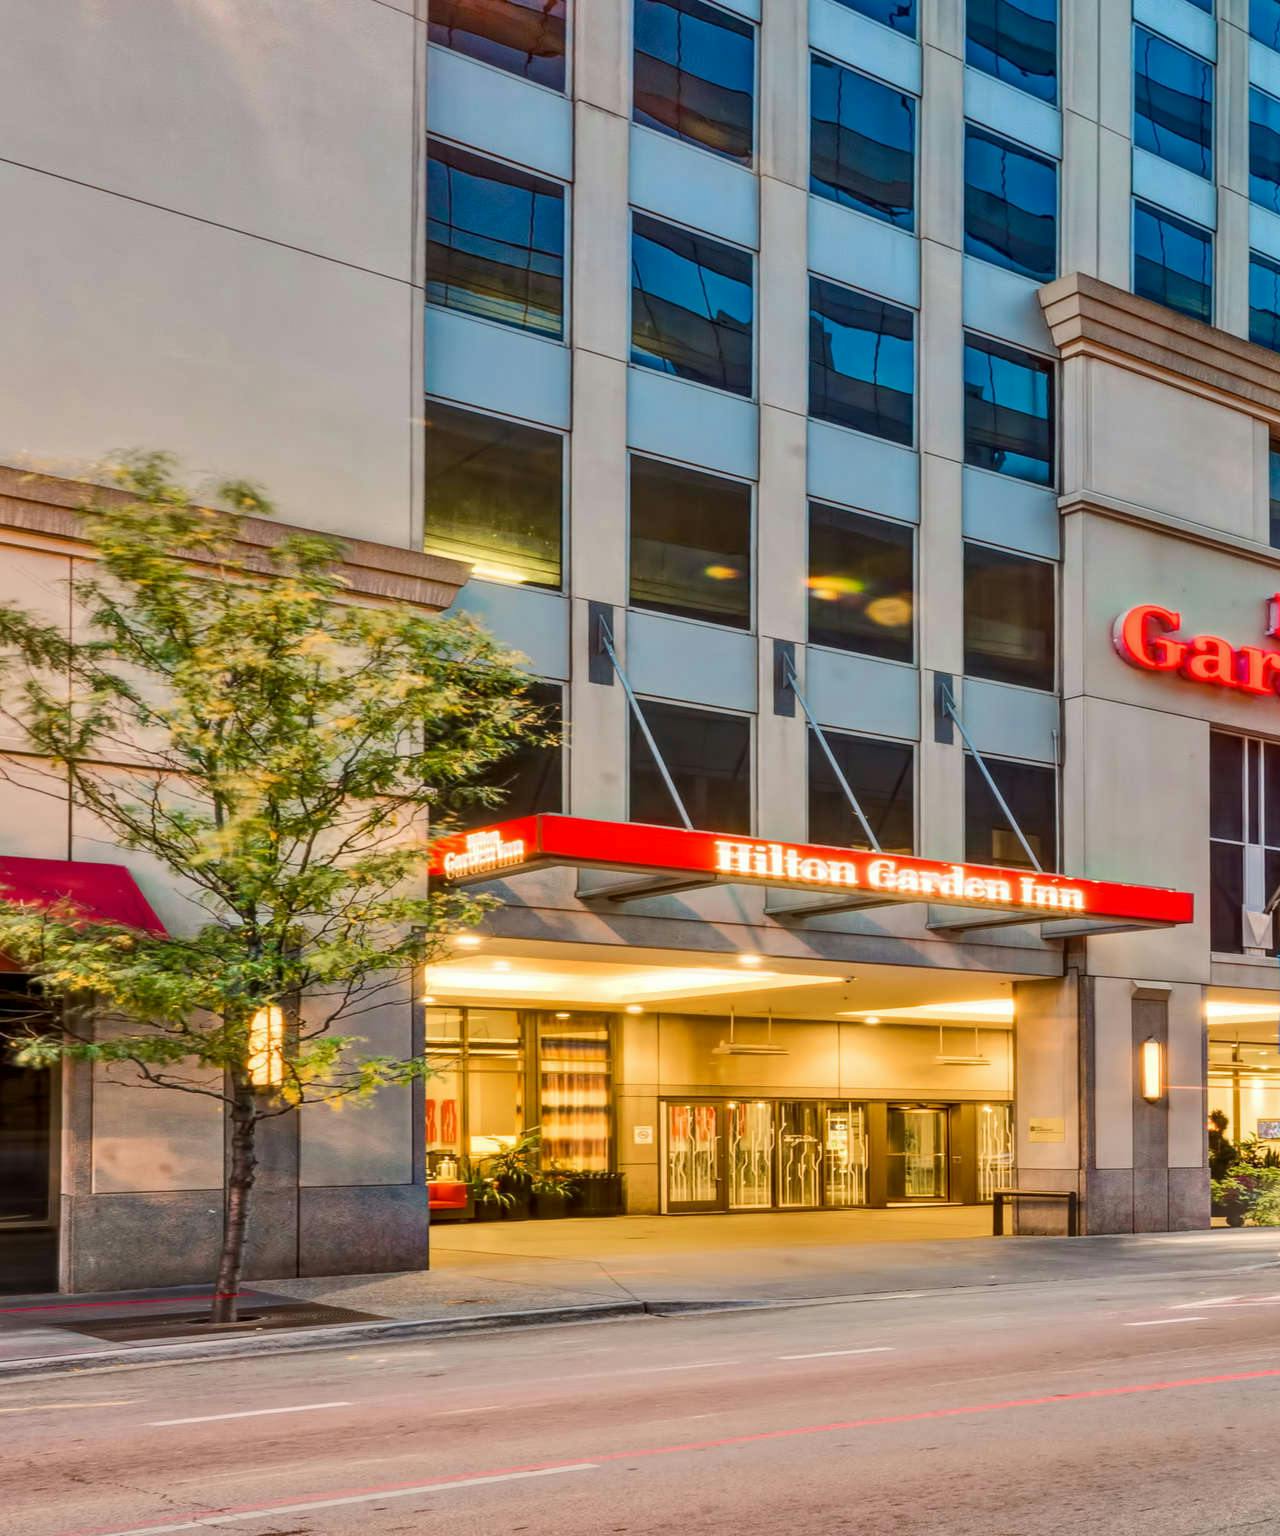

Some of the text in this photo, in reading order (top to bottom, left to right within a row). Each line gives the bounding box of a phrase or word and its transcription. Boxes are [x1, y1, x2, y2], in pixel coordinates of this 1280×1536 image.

[444, 847, 497, 872] Garden
[715, 840, 1084, 909] Hilton Garden Inn
